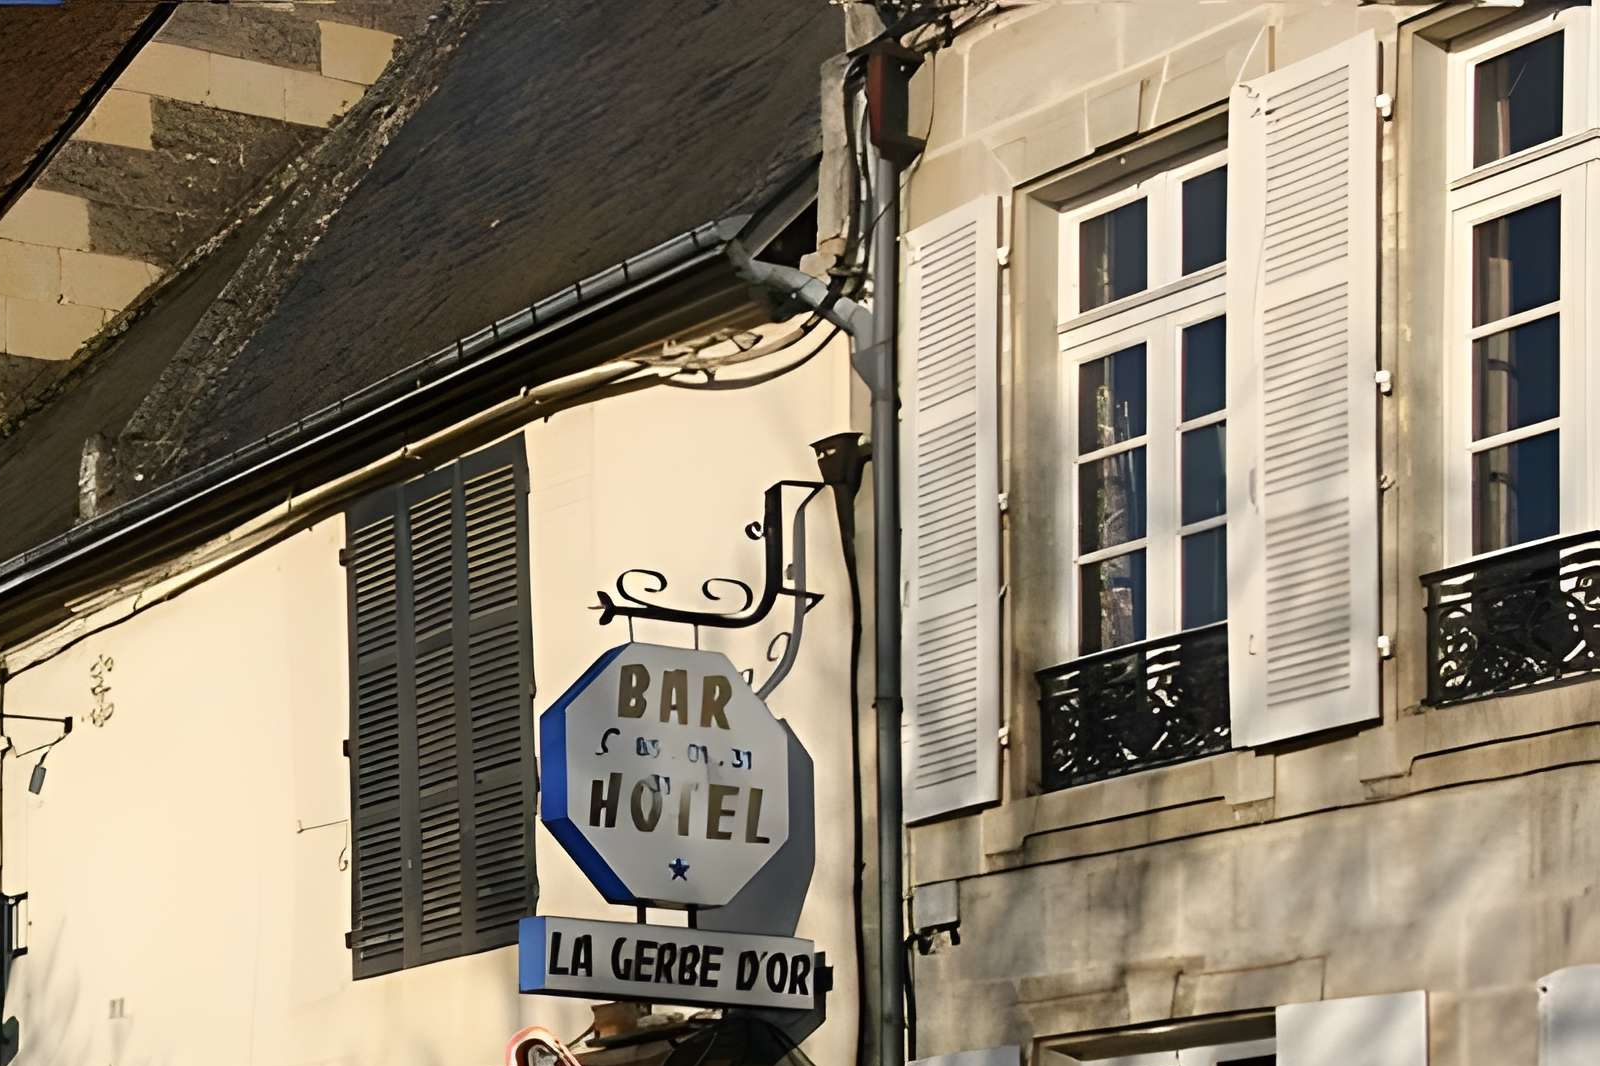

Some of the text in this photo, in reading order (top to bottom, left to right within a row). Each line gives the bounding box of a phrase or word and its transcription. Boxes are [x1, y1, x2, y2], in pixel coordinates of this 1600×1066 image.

[618, 664, 732, 730] BAR
[589, 773, 770, 844] HOTEL
[548, 930, 812, 996] LA GERBE D'OR
